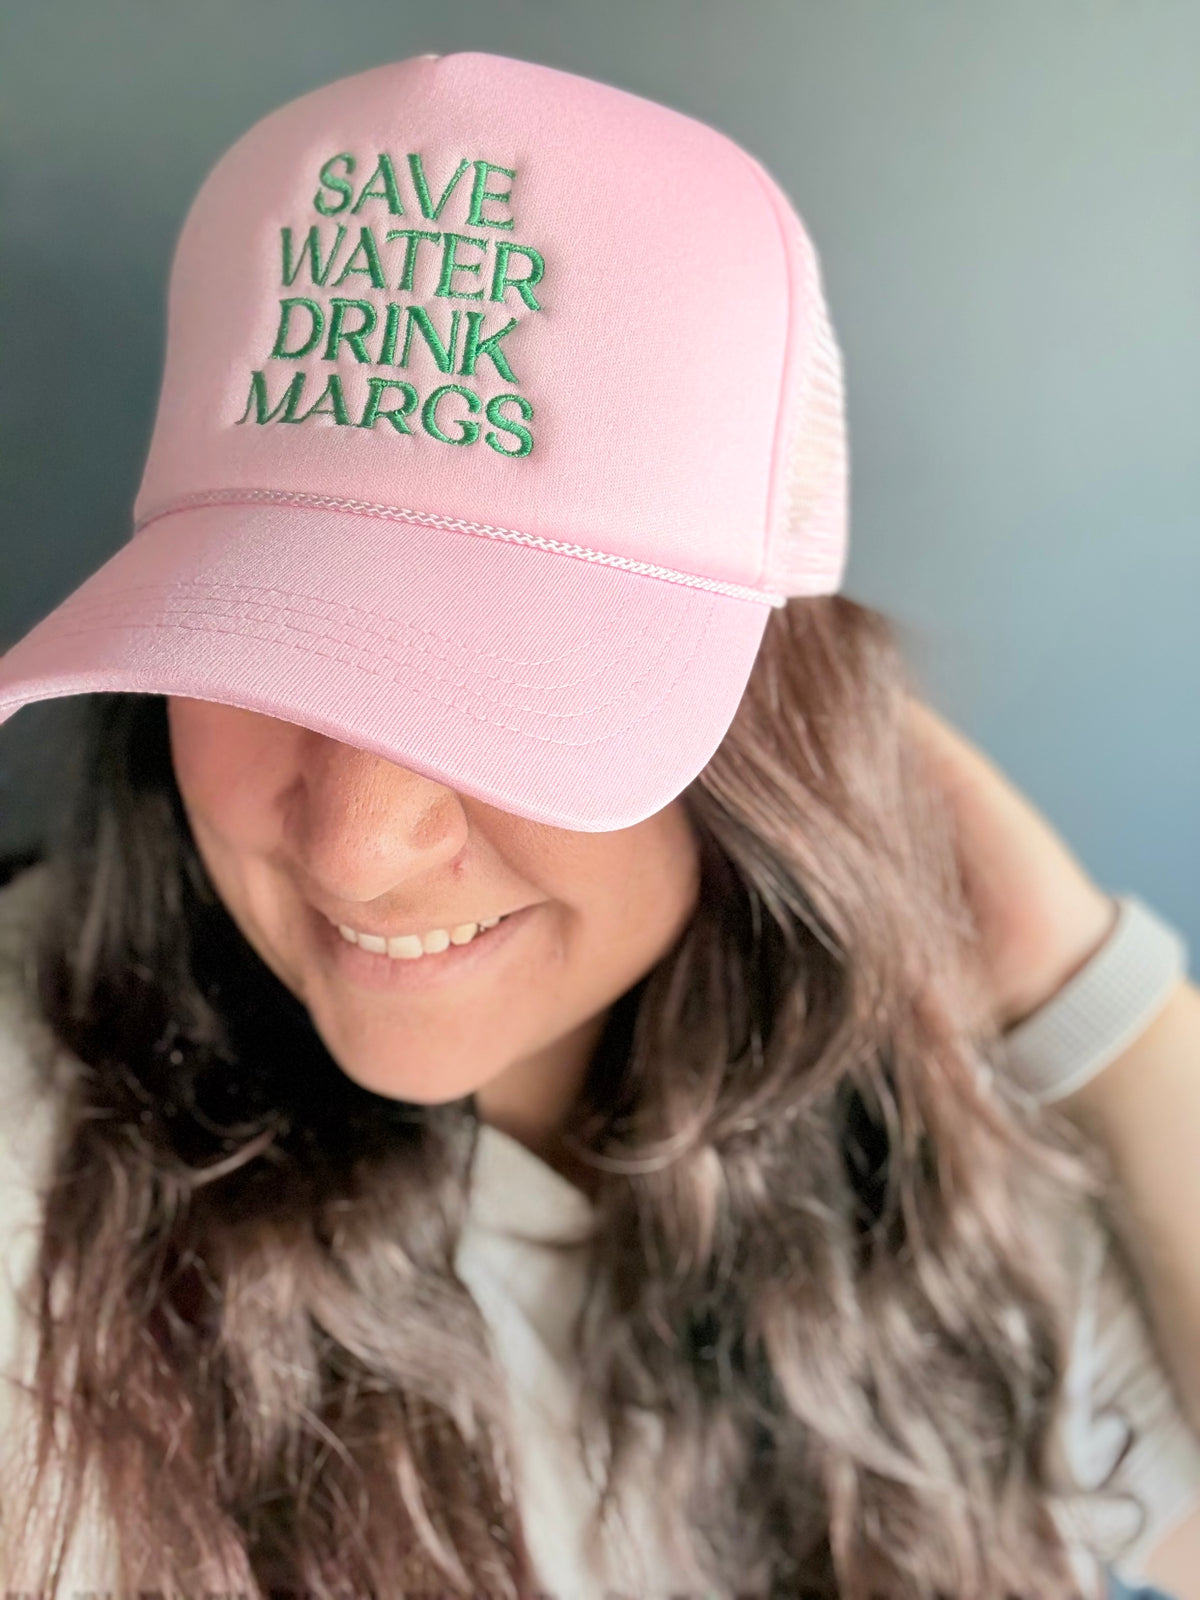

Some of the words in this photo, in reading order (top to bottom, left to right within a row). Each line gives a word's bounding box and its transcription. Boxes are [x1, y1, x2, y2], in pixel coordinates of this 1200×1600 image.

[313, 152, 516, 231] SAVE
[280, 223, 546, 312] WATER
[269, 297, 520, 385] DRINK
[235, 371, 534, 459] MARGS
